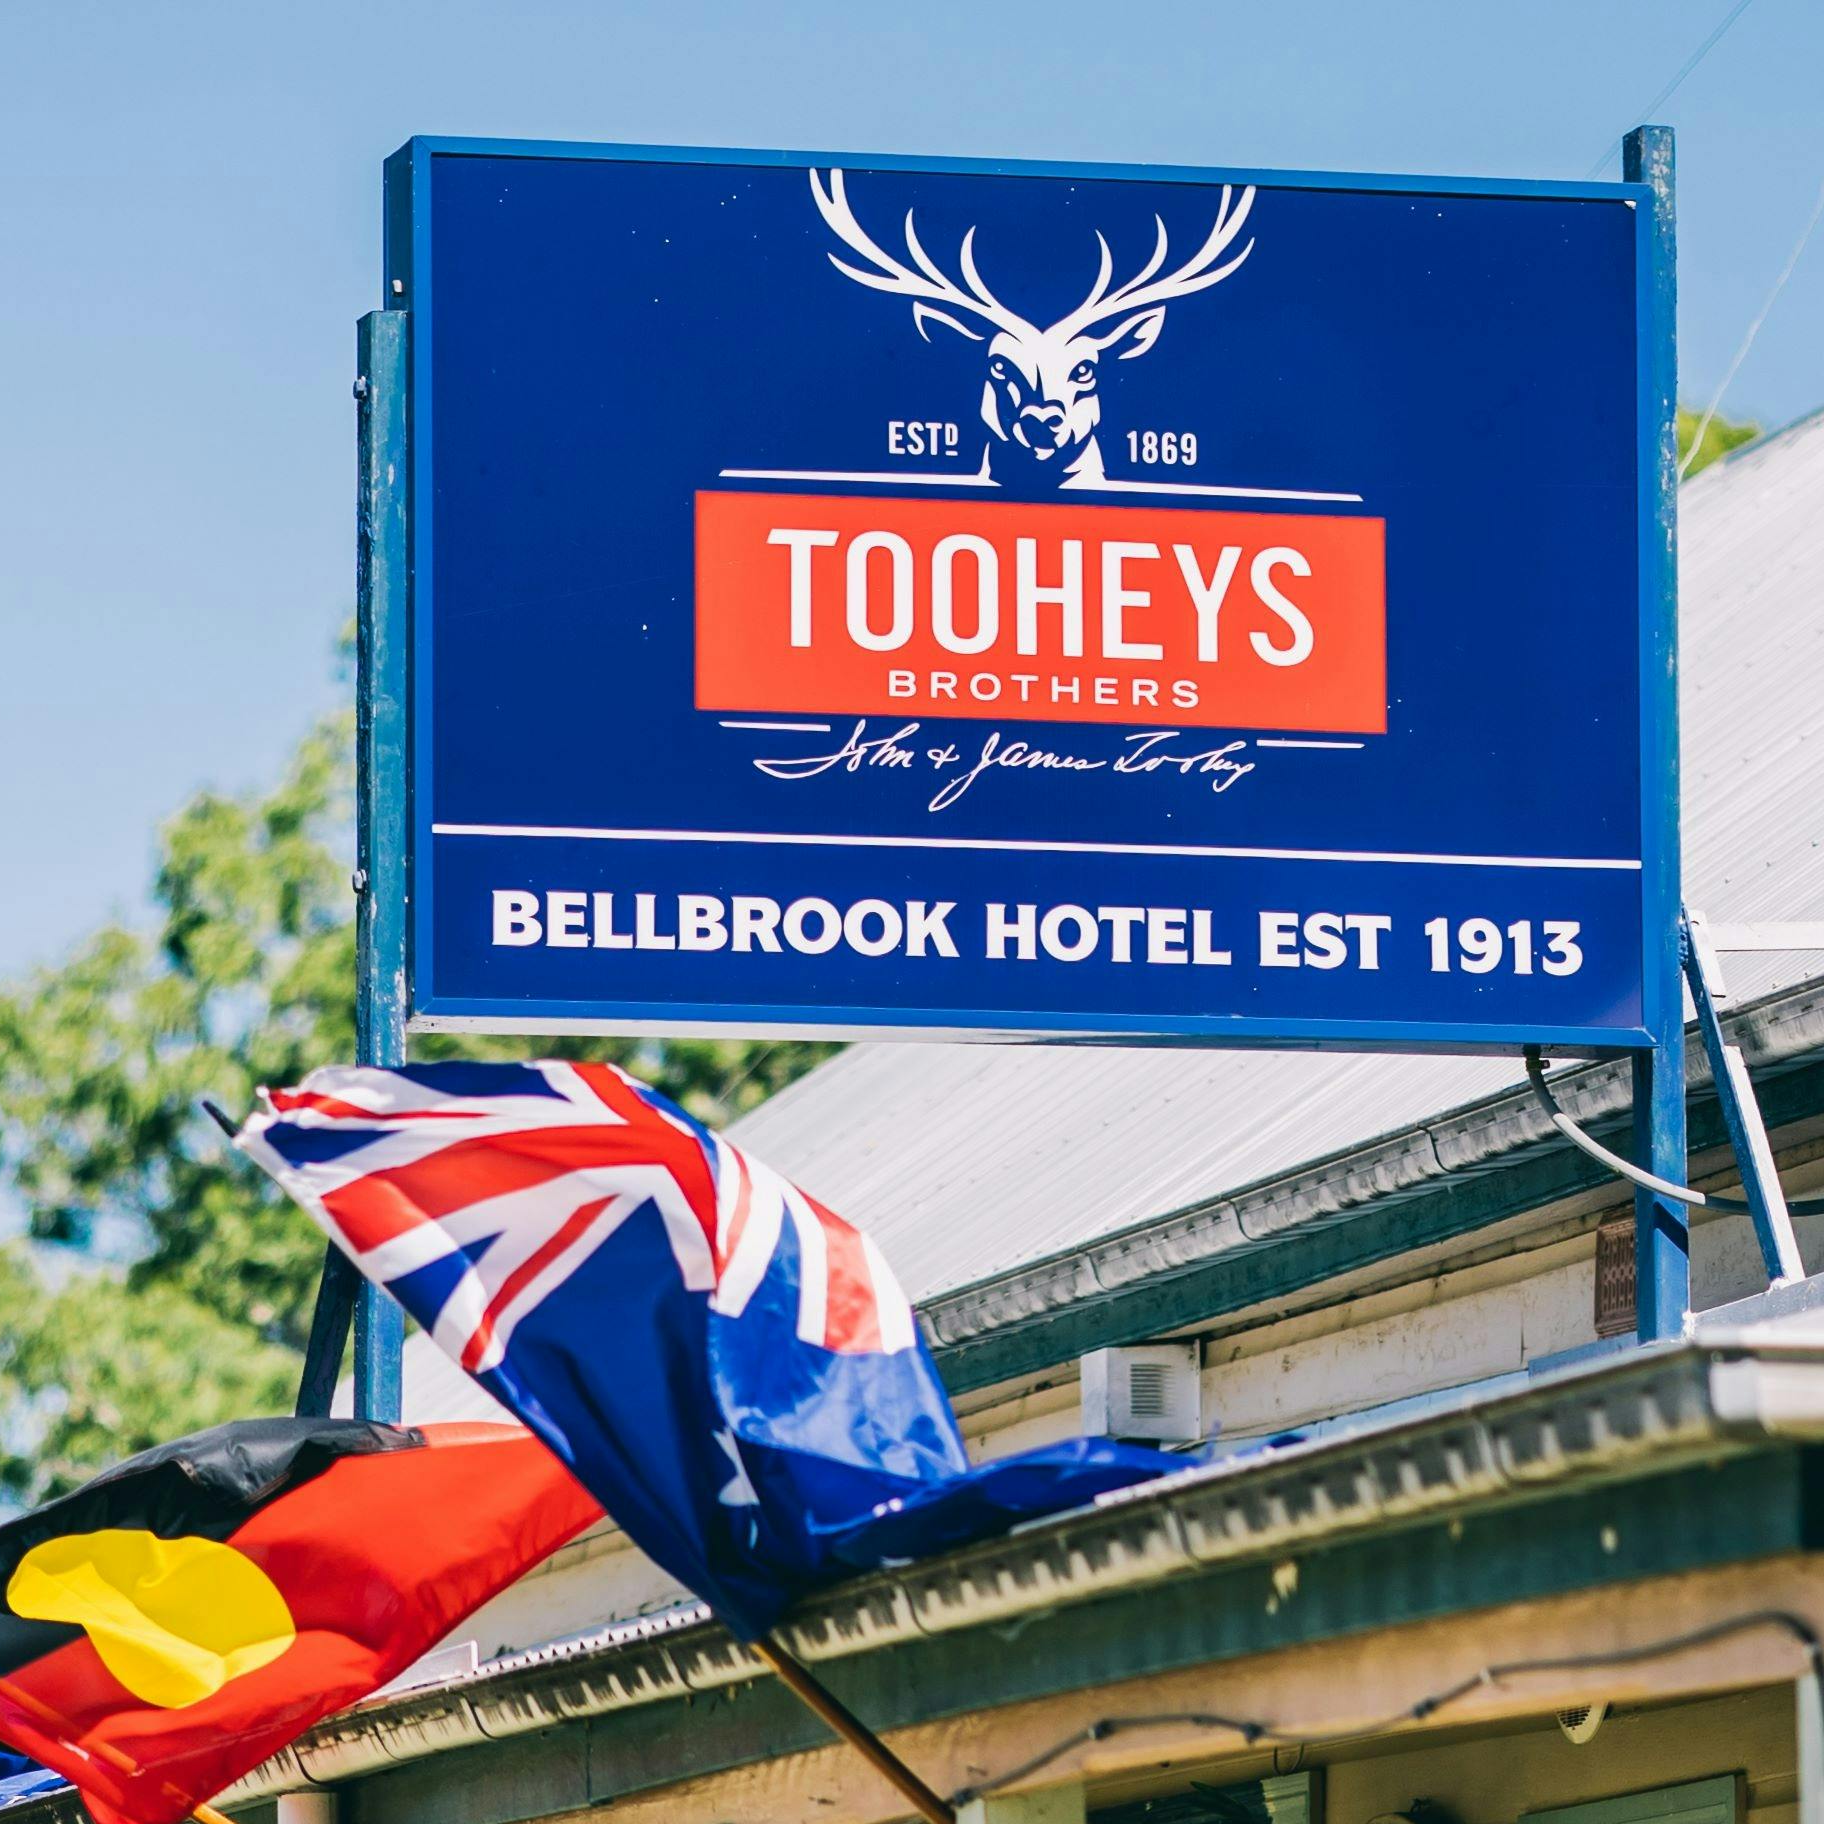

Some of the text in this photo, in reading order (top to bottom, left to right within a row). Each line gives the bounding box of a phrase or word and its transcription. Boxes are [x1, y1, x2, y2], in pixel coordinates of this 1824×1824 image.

[1127, 431, 1198, 466] 1869
[766, 527, 1315, 668] TOOHEYS
[888, 670, 1199, 708] BROTHERS
[754, 719, 920, 779] John
[928, 732, 1107, 812] James
[491, 890, 1584, 978] BELLBROOK HOTEL EST 1913
